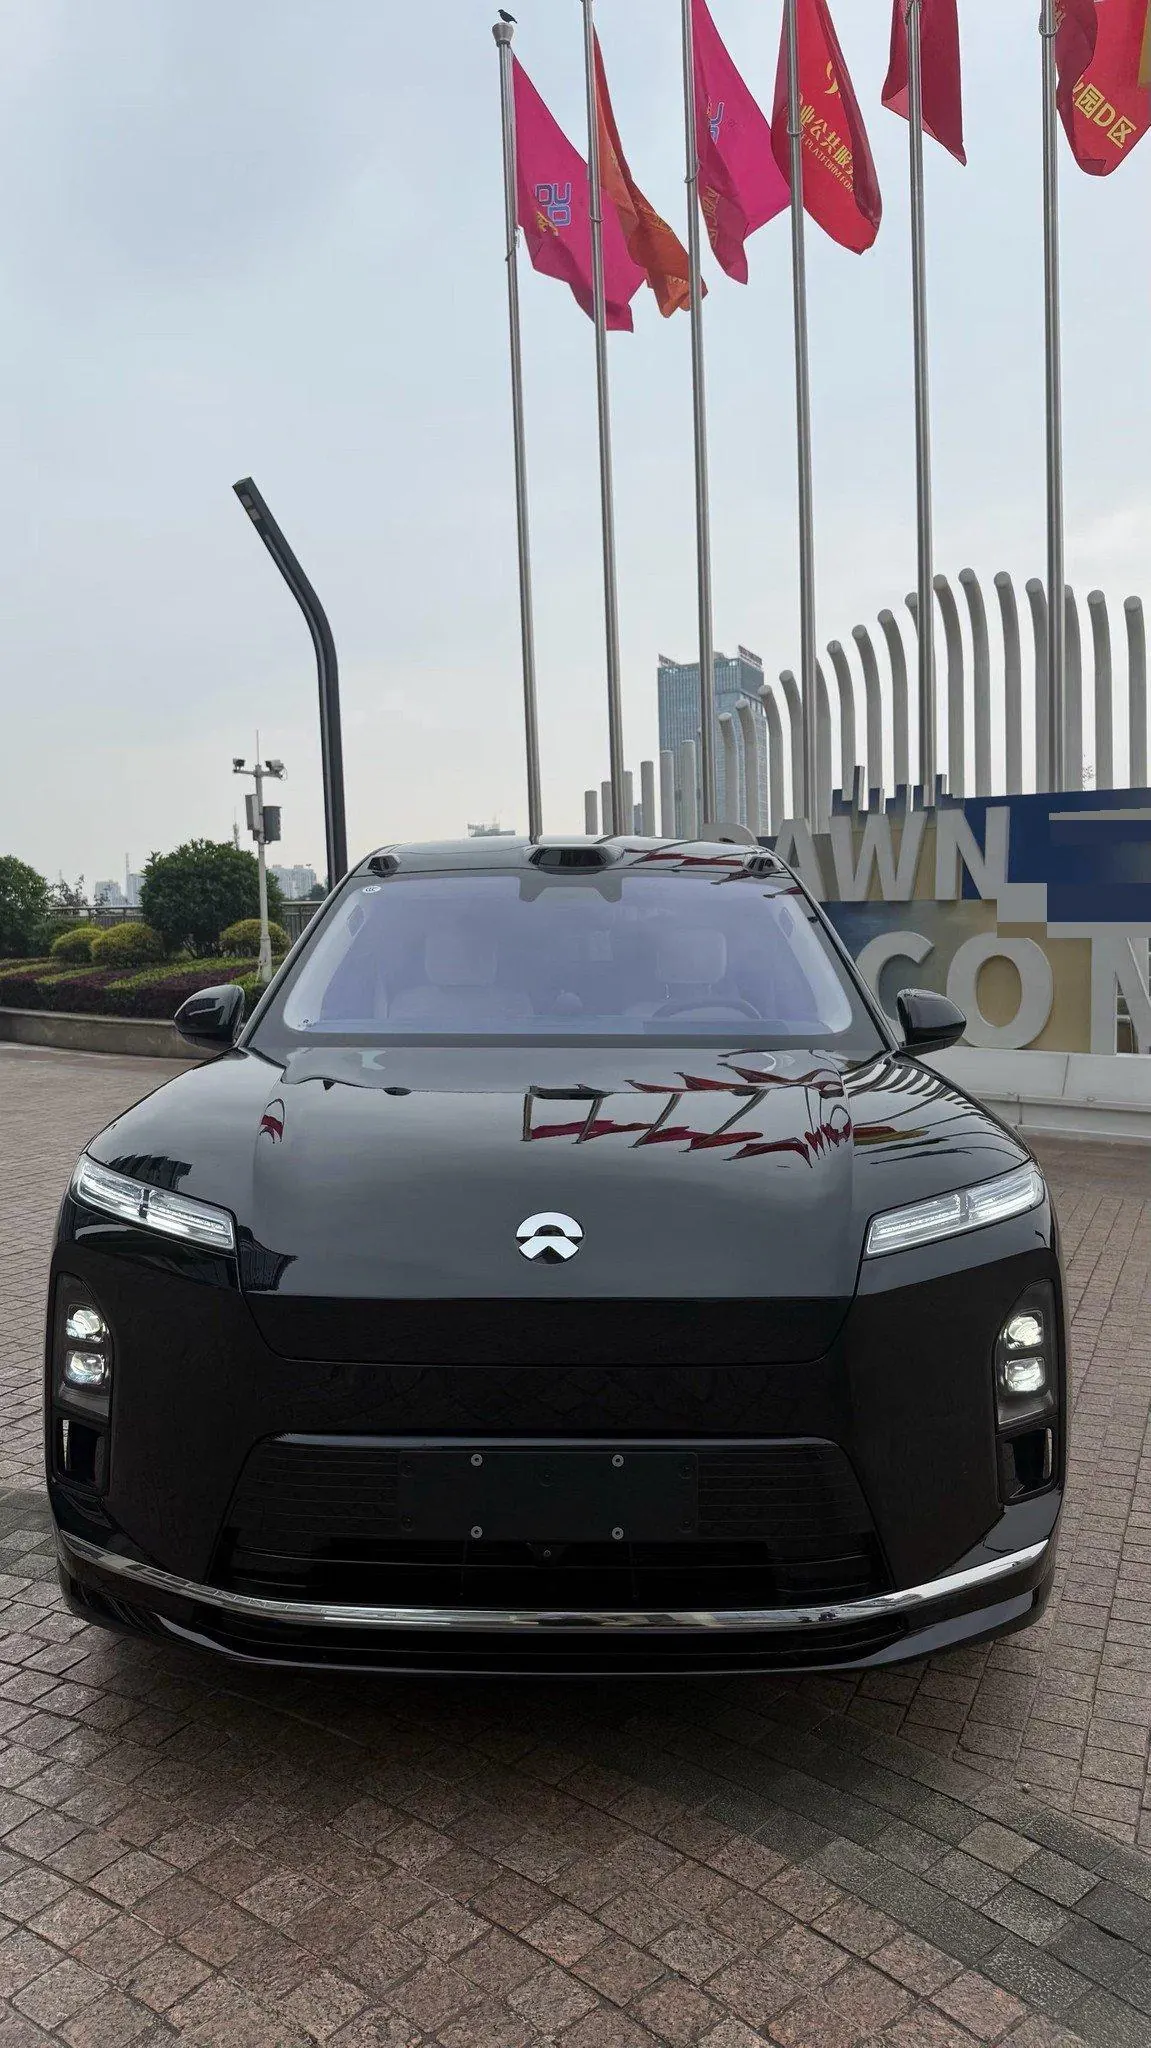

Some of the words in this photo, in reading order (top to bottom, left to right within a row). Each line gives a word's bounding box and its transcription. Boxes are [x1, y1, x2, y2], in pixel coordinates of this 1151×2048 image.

[799, 92, 854, 181] 业公共服
[804, 138, 843, 179] PLATFORM
[702, 806, 1010, 901] AWN
